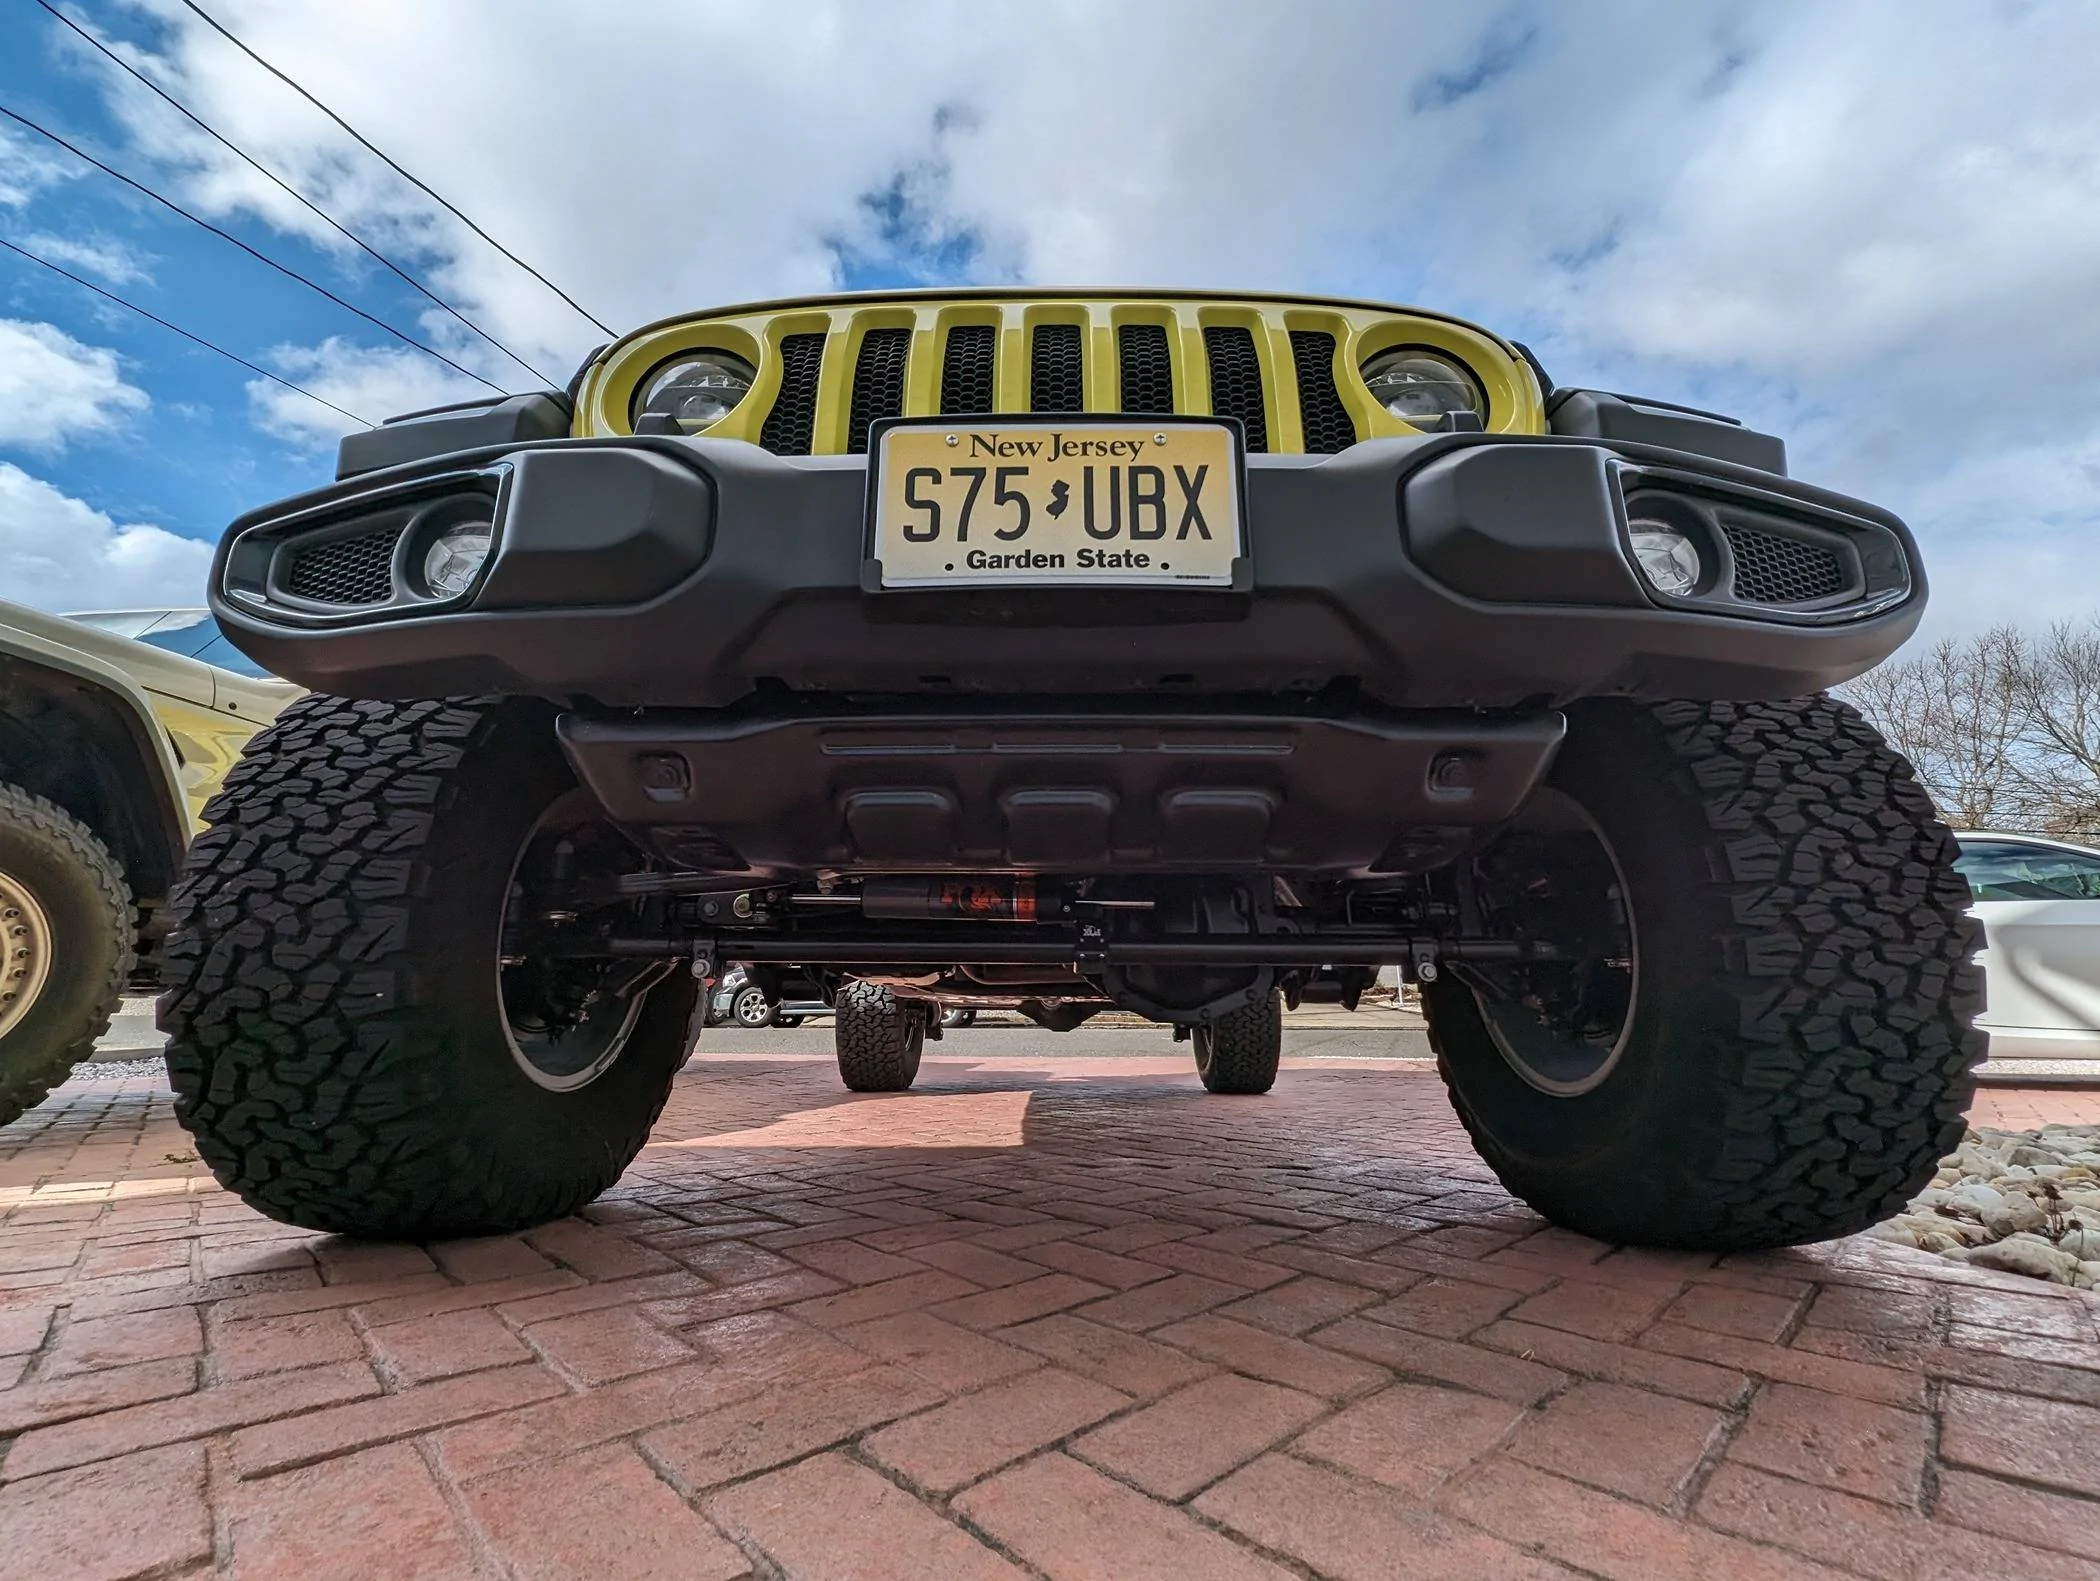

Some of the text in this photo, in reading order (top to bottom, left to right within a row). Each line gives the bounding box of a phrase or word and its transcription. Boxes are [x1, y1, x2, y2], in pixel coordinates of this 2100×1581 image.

[969, 433, 1145, 463] New Jersey
[902, 464, 1213, 543] S75 UBX
[966, 548, 1150, 570] Garden State
